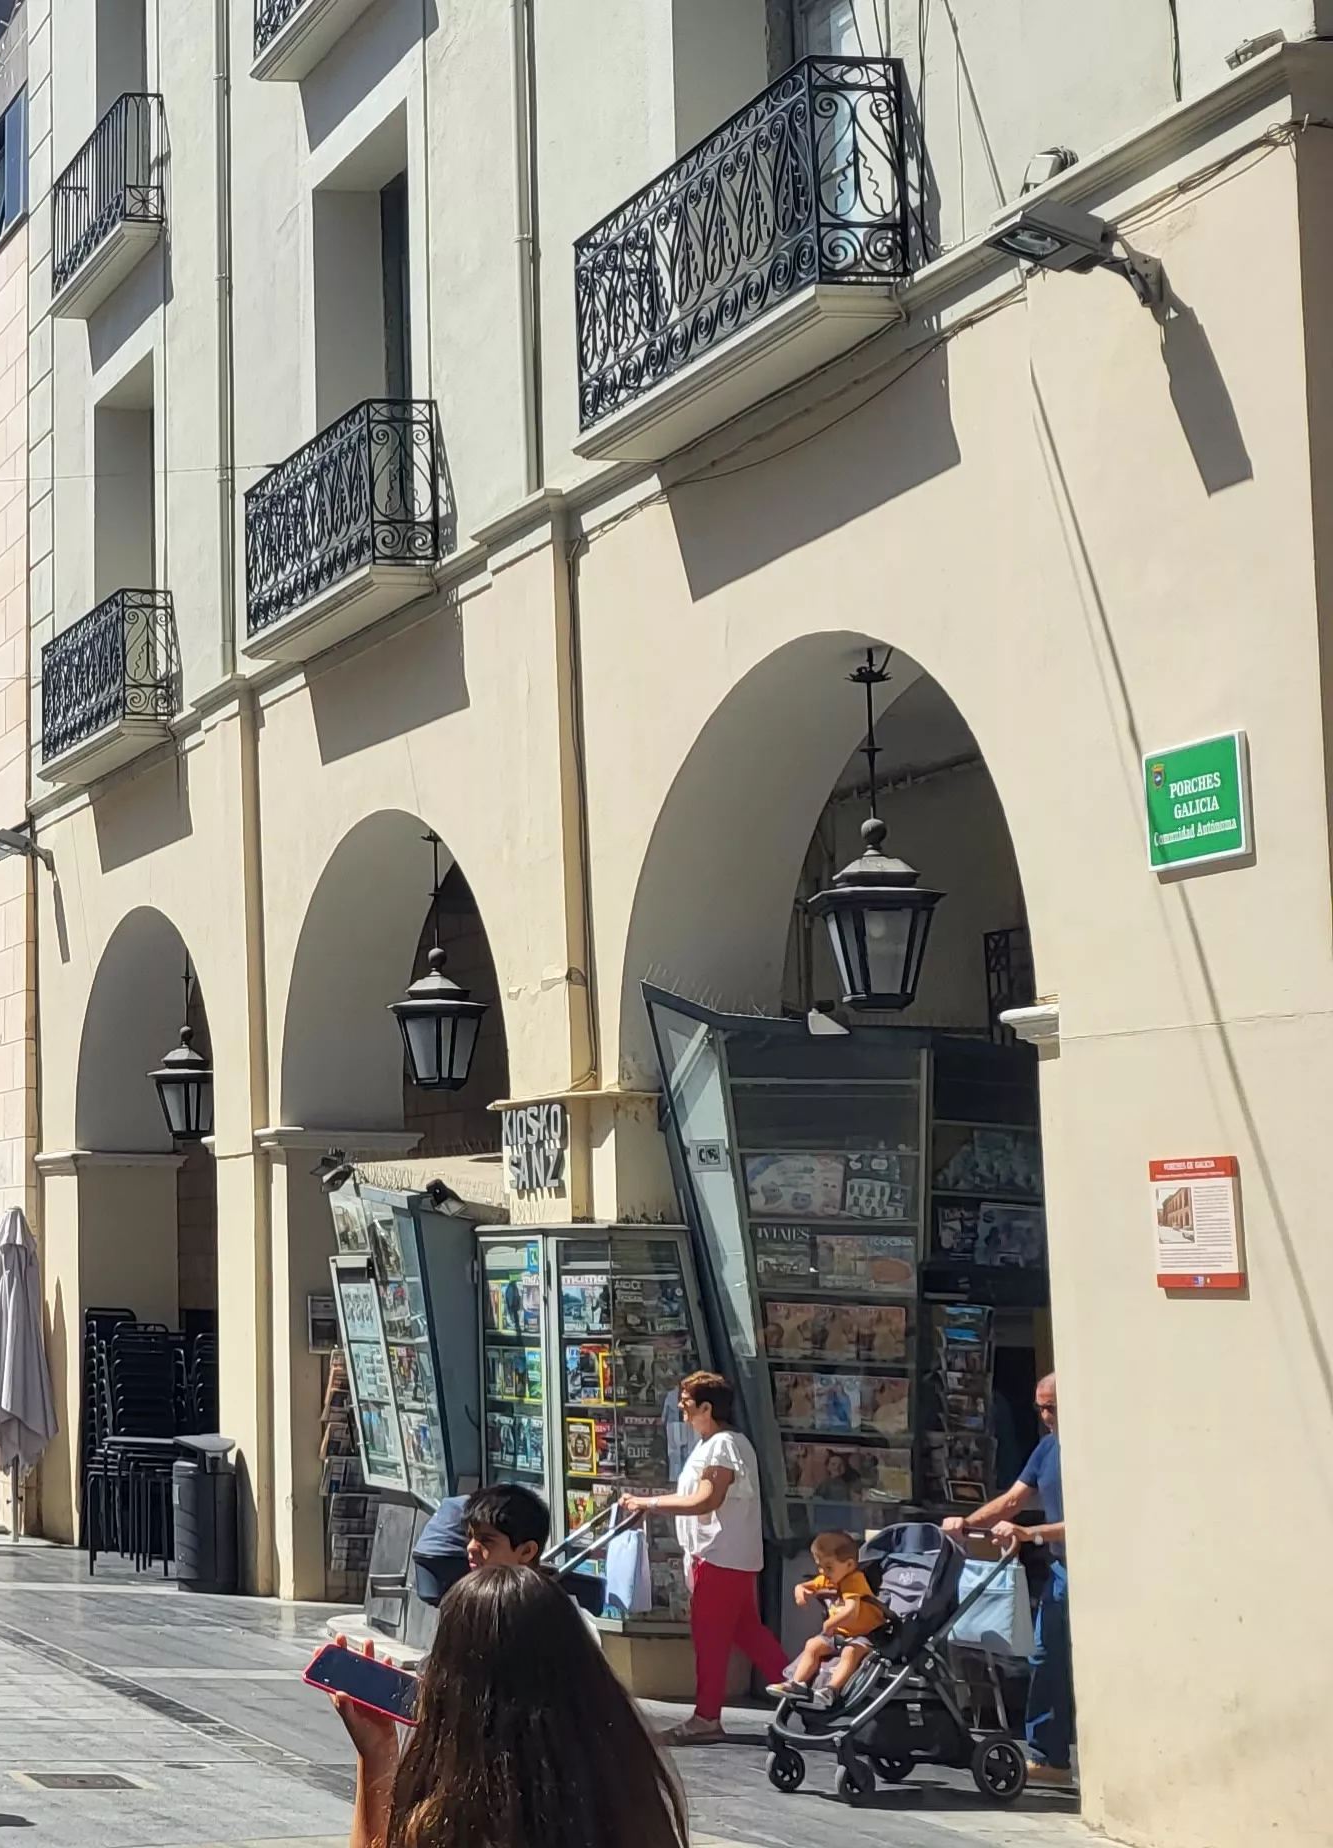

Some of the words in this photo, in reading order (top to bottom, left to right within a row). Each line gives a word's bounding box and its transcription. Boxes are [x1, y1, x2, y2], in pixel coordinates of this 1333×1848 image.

[1169, 772, 1221, 799] PORCHES
[1174, 796, 1220, 819] GALICIA
[1154, 824, 1195, 847] Comunidad
[502, 1103, 562, 1146] KIOSKO
[509, 1147, 559, 1190] SANZ
